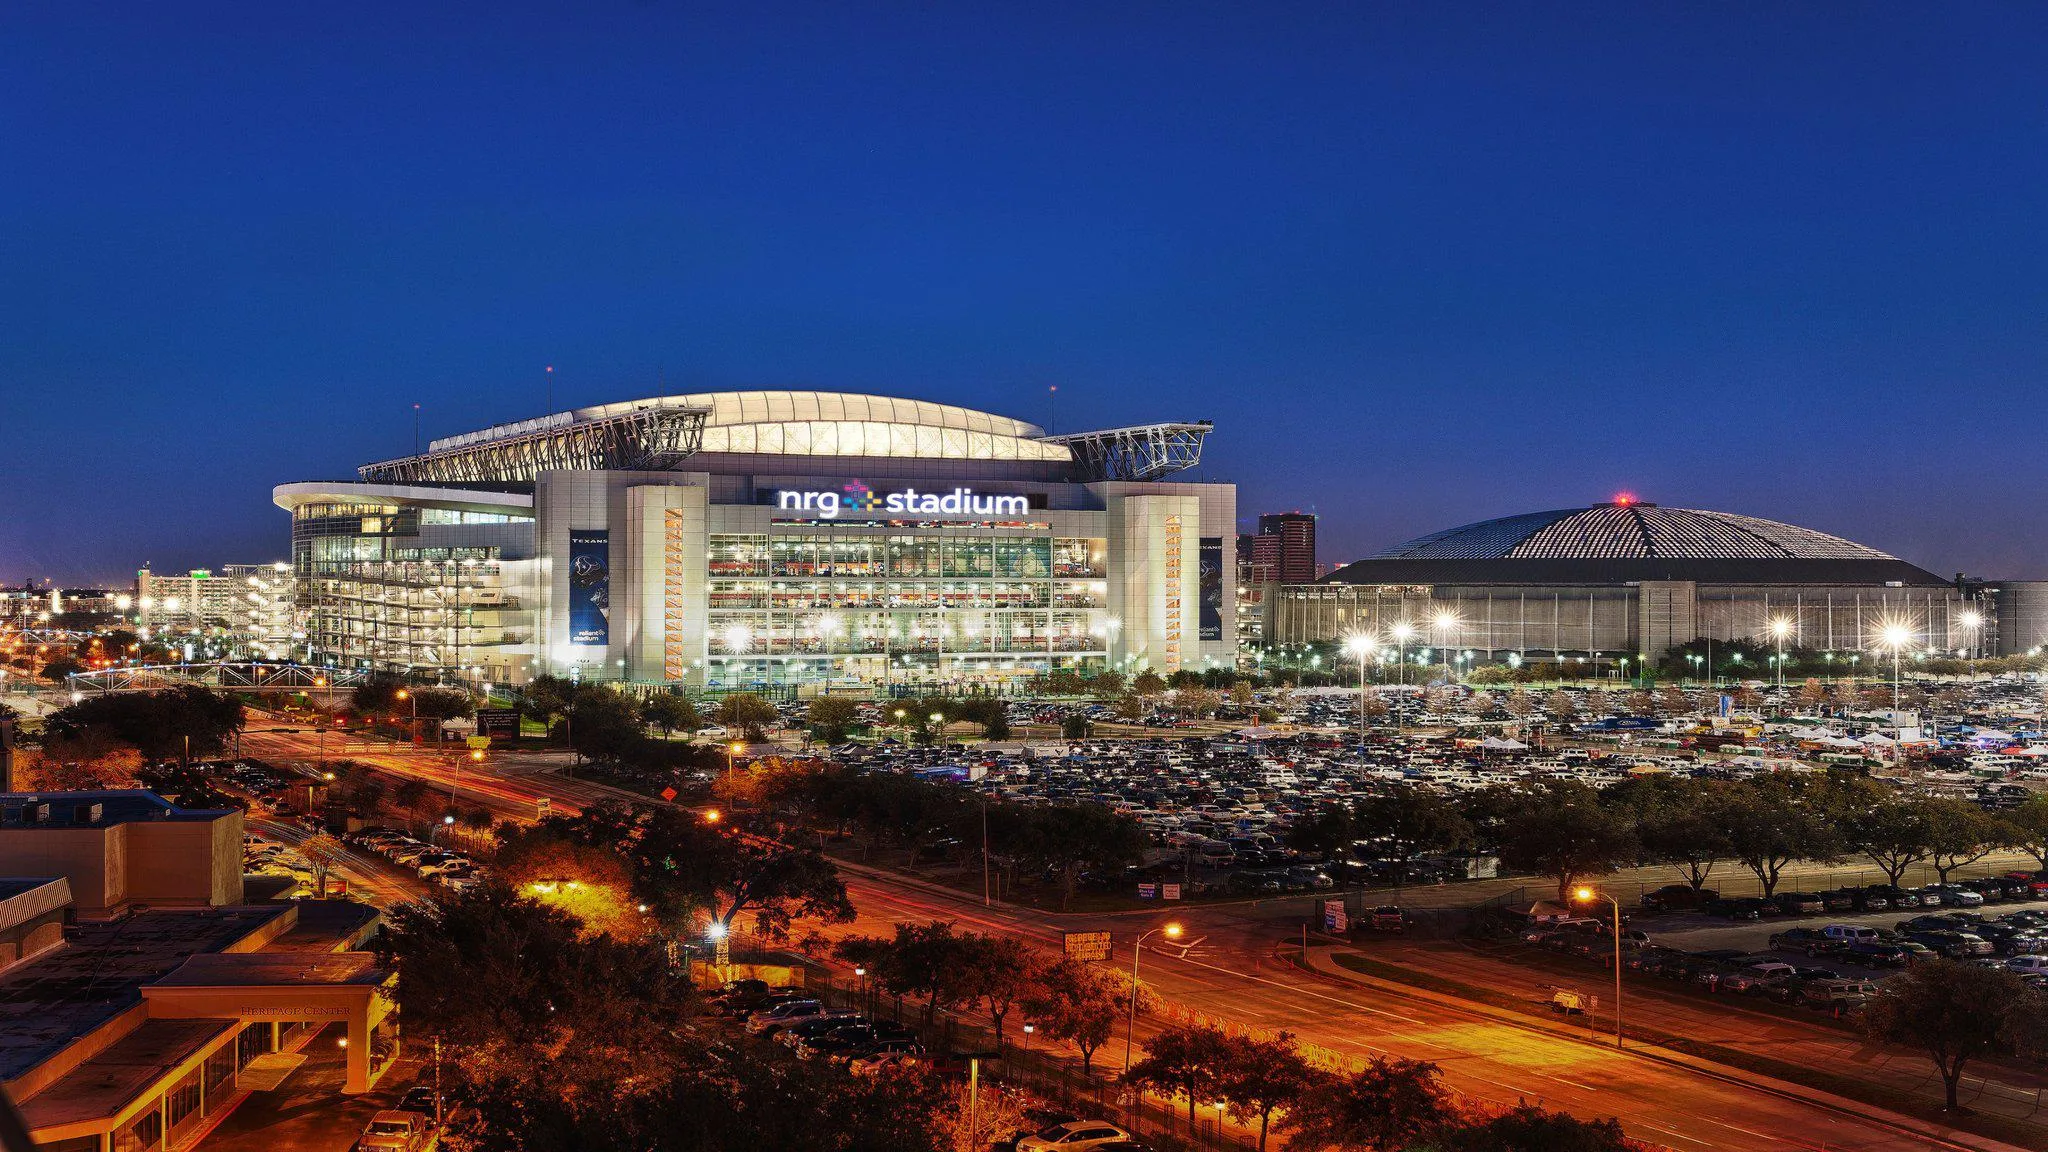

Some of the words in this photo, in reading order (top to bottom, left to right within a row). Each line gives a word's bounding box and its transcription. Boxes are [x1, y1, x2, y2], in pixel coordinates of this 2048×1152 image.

[779, 490, 839, 518] nrg
[885, 487, 1029, 516] stadium
[240, 1006, 301, 1016] HERITAGE
[303, 1006, 351, 1016] CENTER
